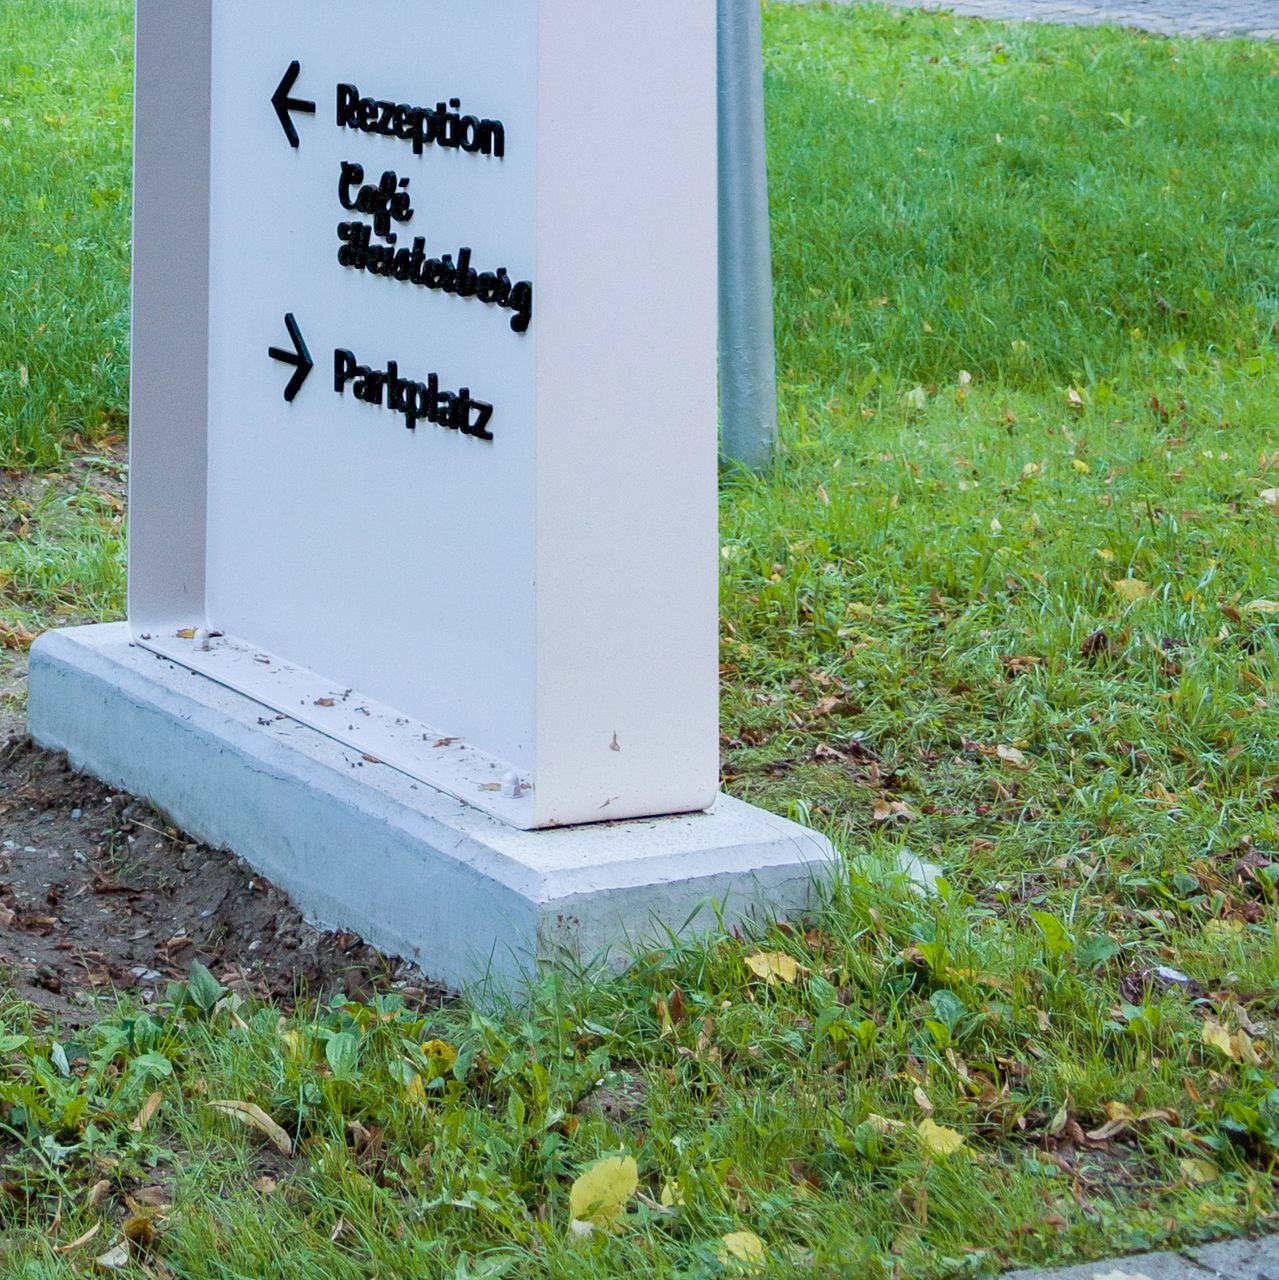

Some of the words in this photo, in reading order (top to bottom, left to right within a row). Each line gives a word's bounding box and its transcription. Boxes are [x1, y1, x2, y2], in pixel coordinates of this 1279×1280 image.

[337, 83, 505, 158] Rezeption
[339, 161, 414, 237] Café
[334, 348, 494, 440] Parkplatz
